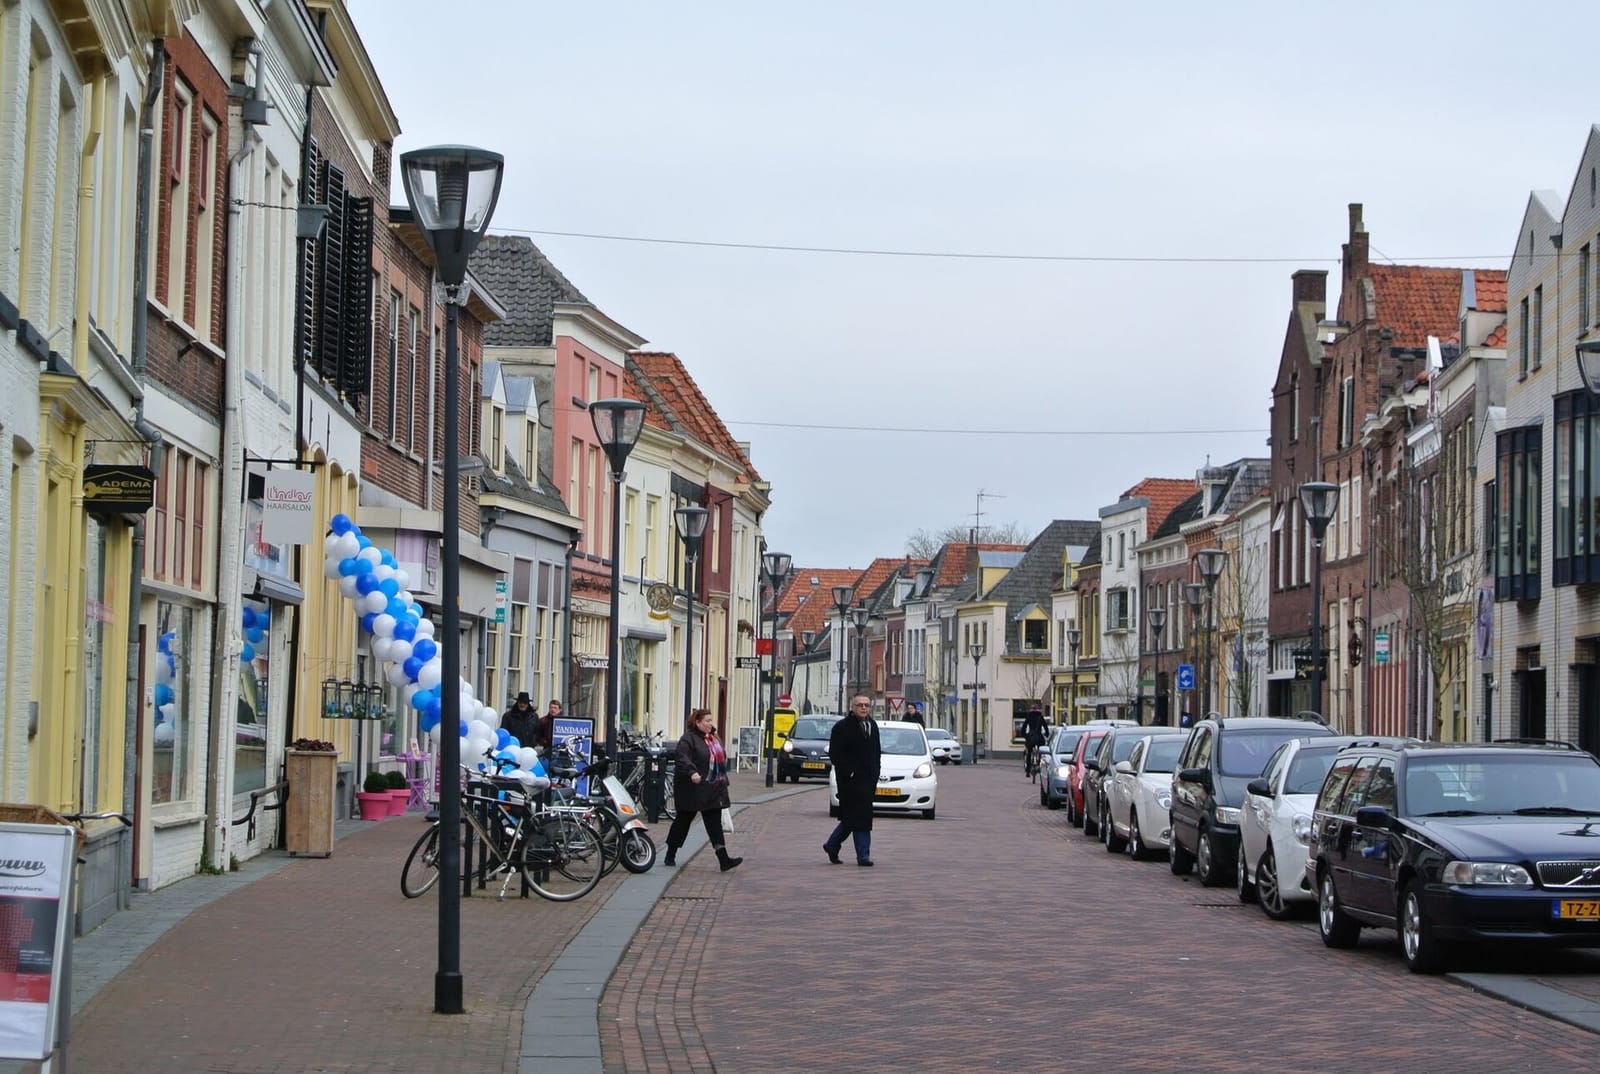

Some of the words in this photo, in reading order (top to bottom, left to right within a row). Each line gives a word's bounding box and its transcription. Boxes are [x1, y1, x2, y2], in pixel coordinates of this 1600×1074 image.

[102, 480, 151, 488] ADEMA
[266, 503, 312, 512] HAARSALON
[555, 725, 590, 735] VANDAAG
[1566, 903, 1600, 916] TZ-Z
